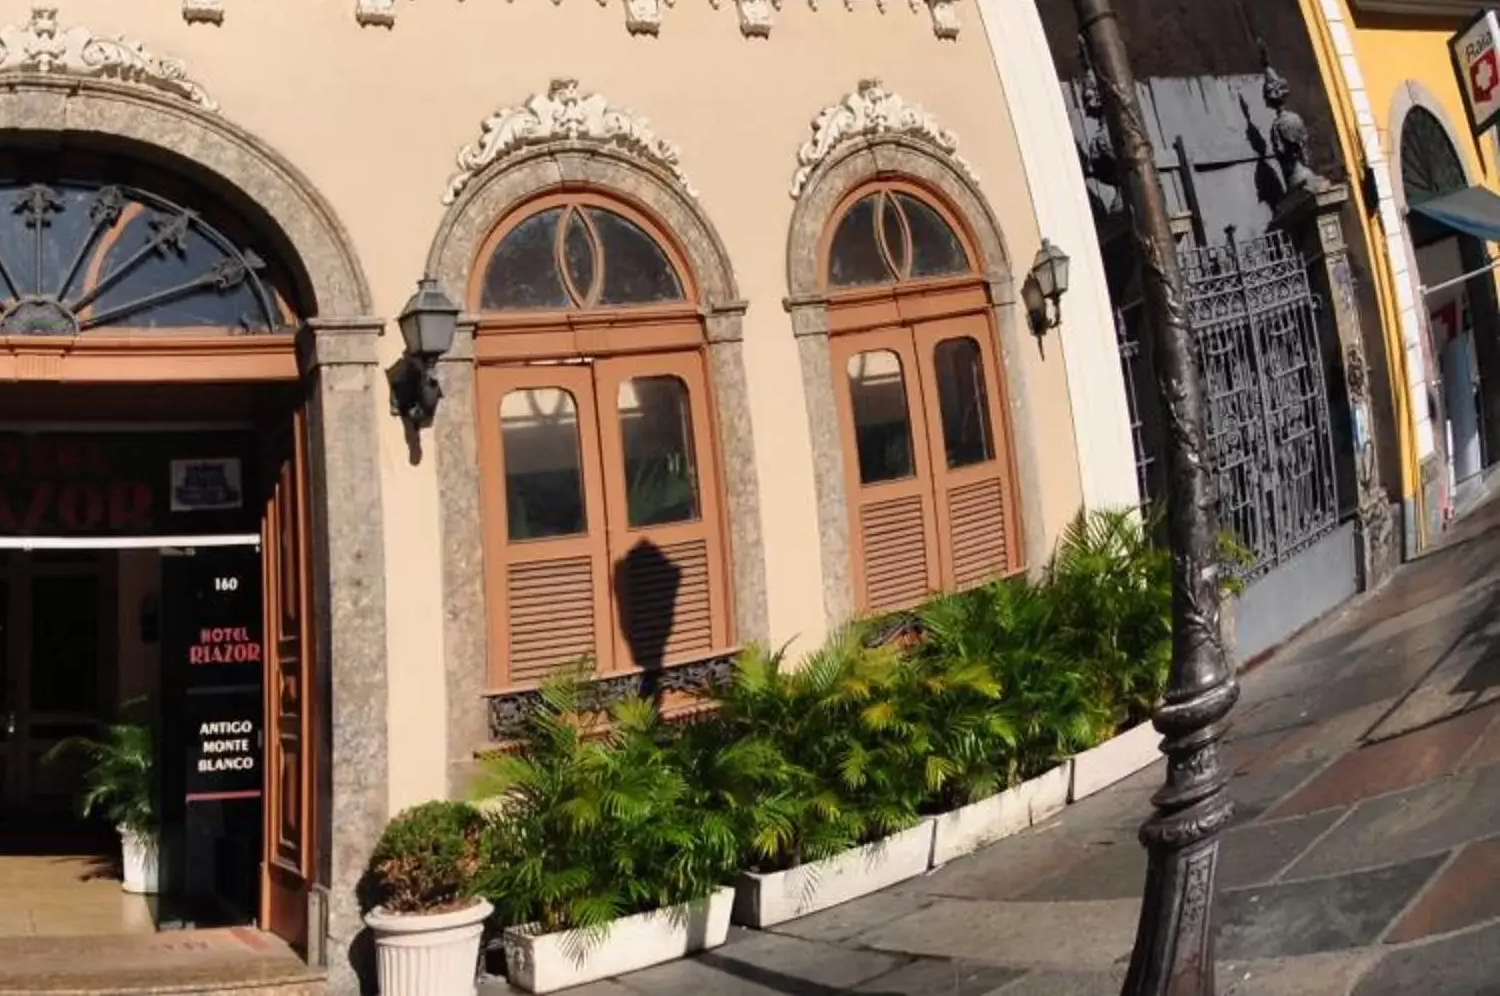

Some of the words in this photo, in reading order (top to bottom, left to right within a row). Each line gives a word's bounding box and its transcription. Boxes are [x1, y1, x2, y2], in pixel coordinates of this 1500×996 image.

[213, 577, 239, 591] 160
[200, 626, 250, 643] HOTEL
[189, 642, 261, 664] RIAZOR
[200, 720, 253, 735] ANTIGO
[202, 738, 249, 753] MONTE
[197, 756, 254, 772] BLANCO
